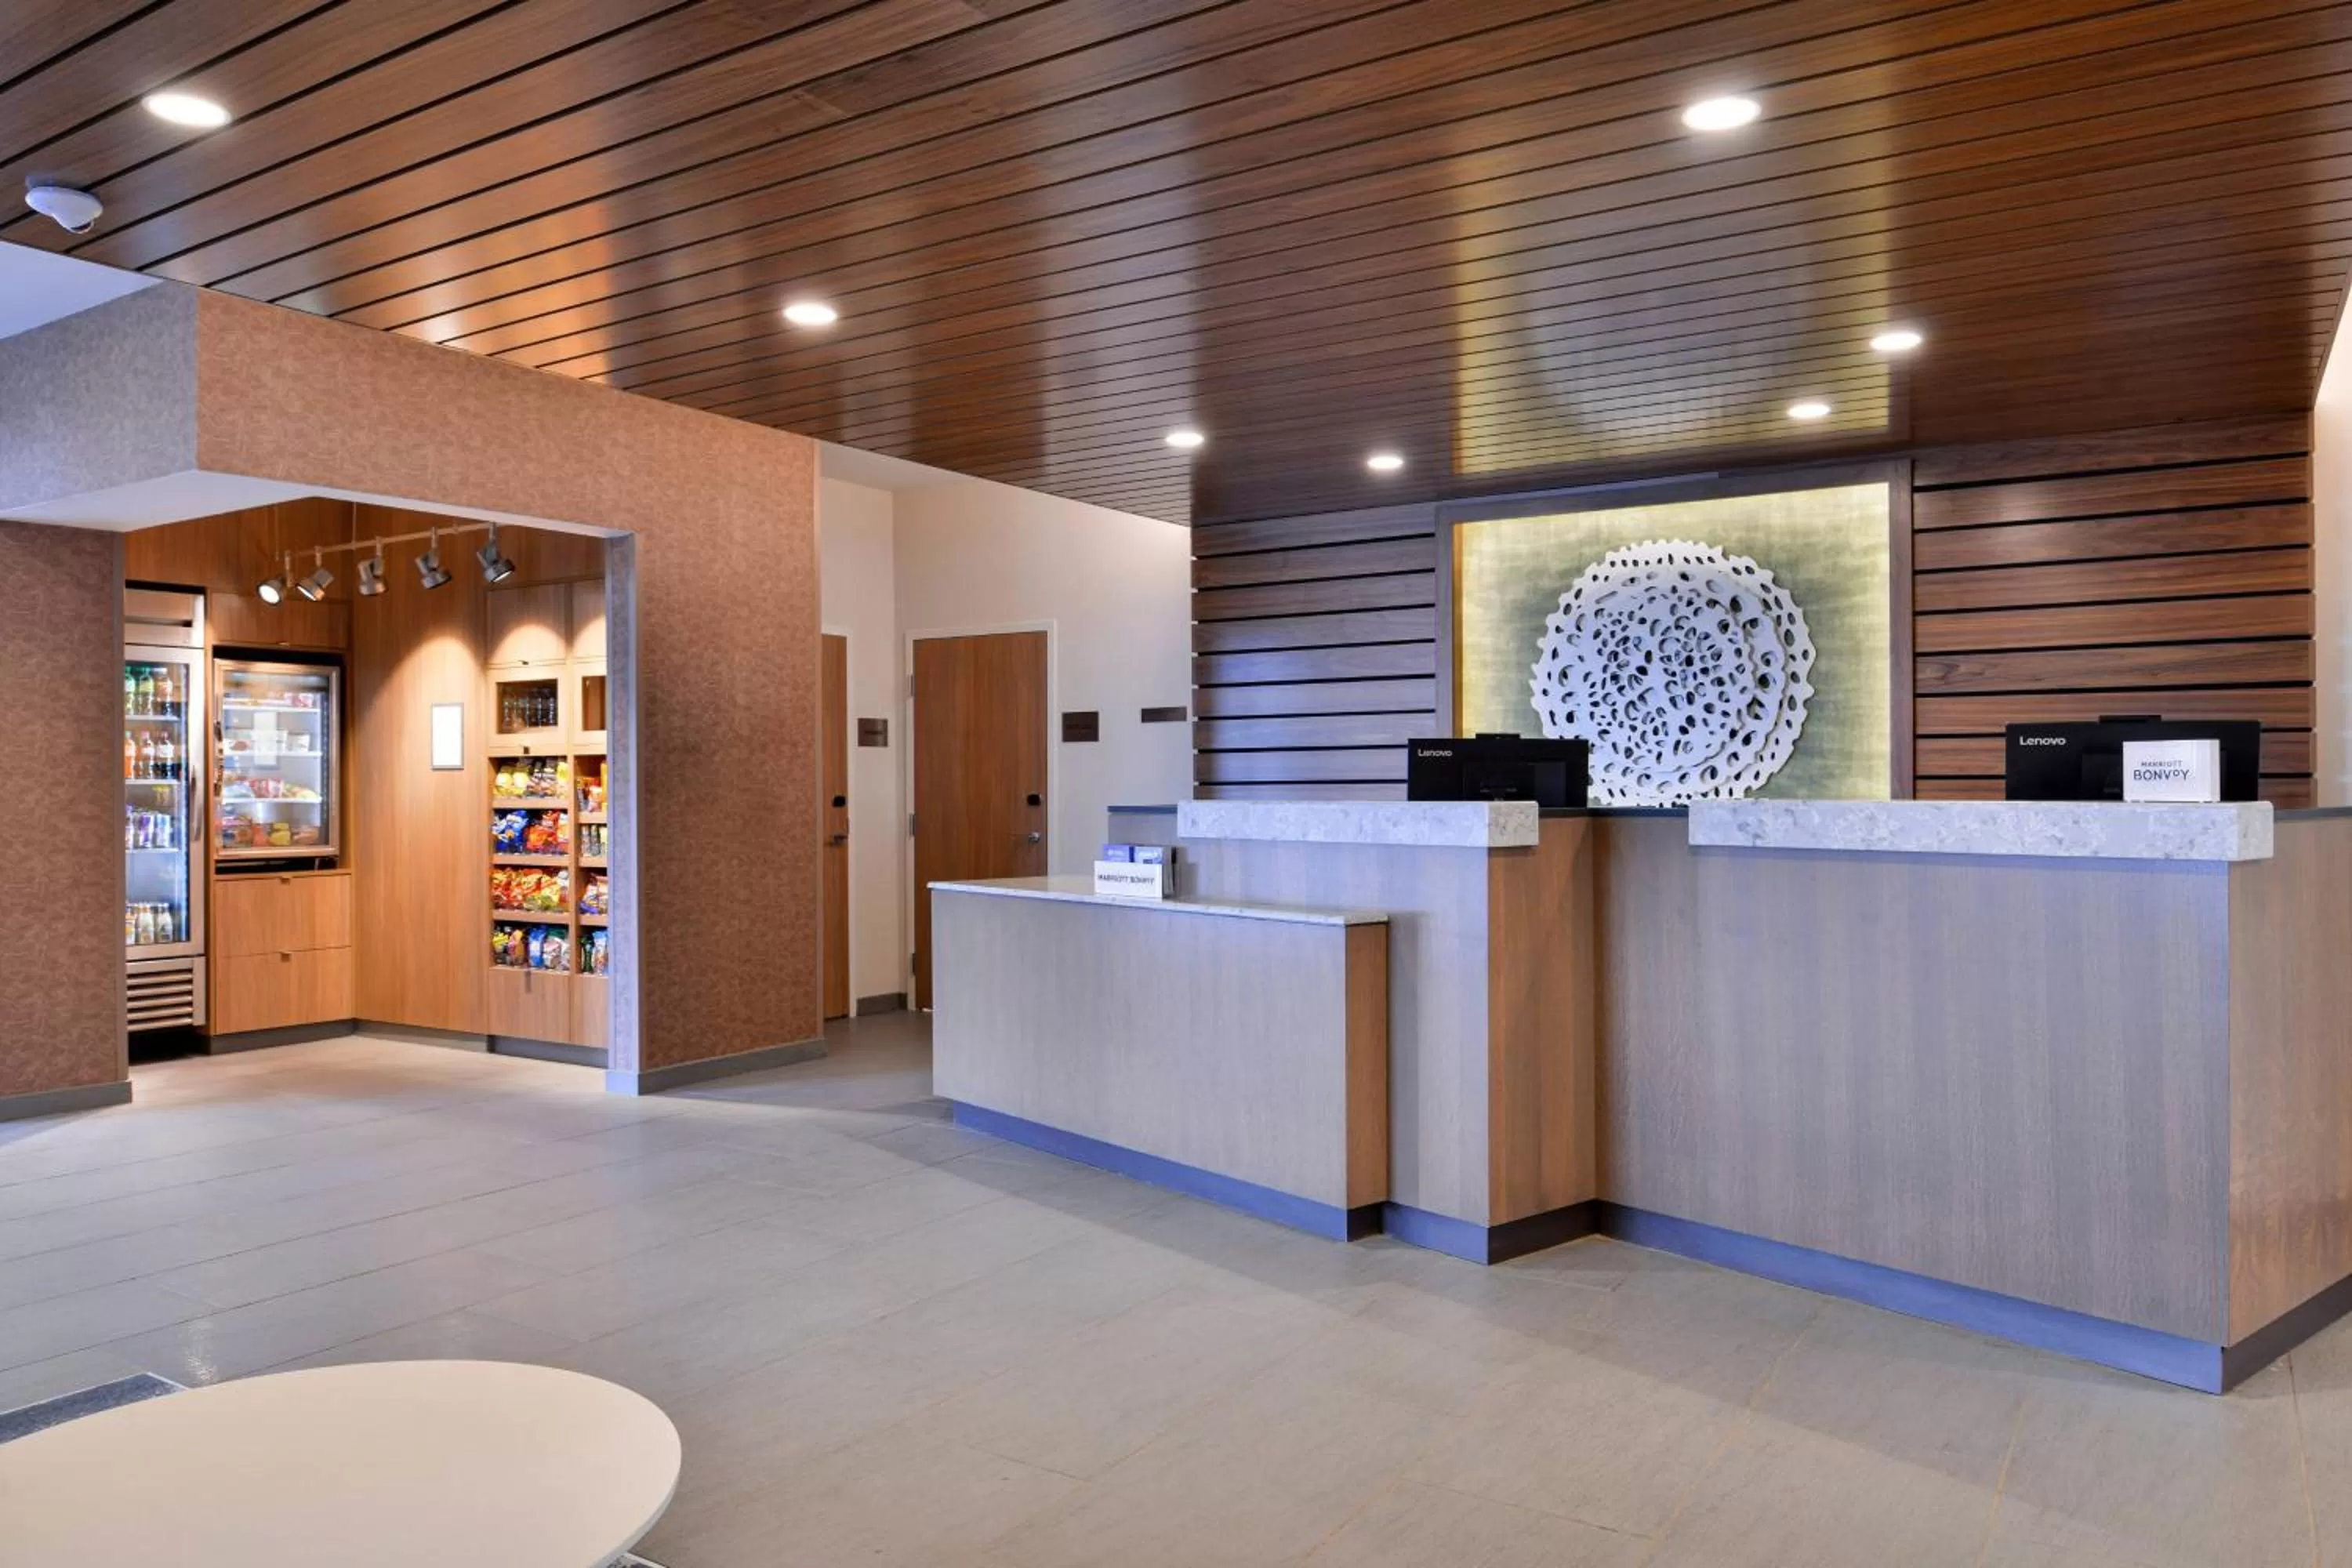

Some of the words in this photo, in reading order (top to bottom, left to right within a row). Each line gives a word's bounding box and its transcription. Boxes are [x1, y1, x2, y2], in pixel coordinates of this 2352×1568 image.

[2020, 735, 2067, 746] Lenovo
[1417, 749, 1453, 757] Lenovo
[2133, 769, 2190, 782] BONVOY
